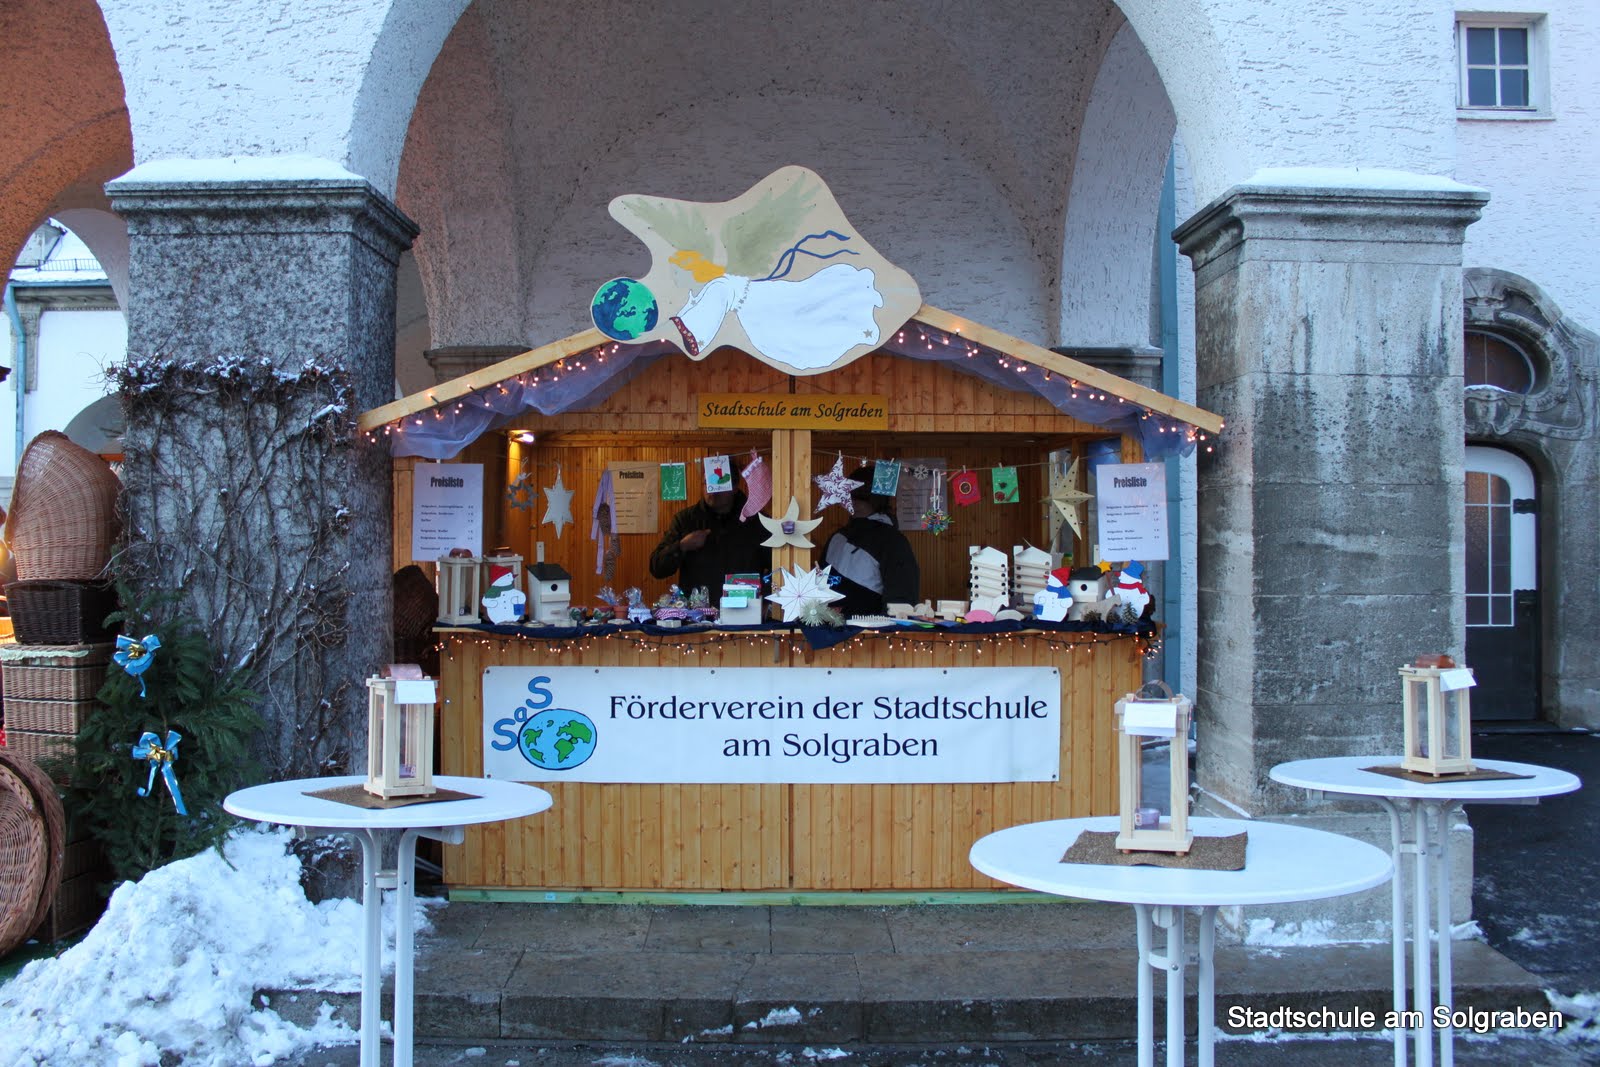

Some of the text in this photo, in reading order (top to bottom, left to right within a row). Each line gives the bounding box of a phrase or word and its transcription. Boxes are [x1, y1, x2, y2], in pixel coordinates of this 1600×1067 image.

[703, 400, 883, 421] Stadtschule am Solgraben
[430, 476, 464, 488] Preisliste
[1113, 476, 1148, 488] Preisliste
[609, 695, 1049, 720] Förderverein der Stadtschule
[722, 732, 939, 764] am Solgraben
